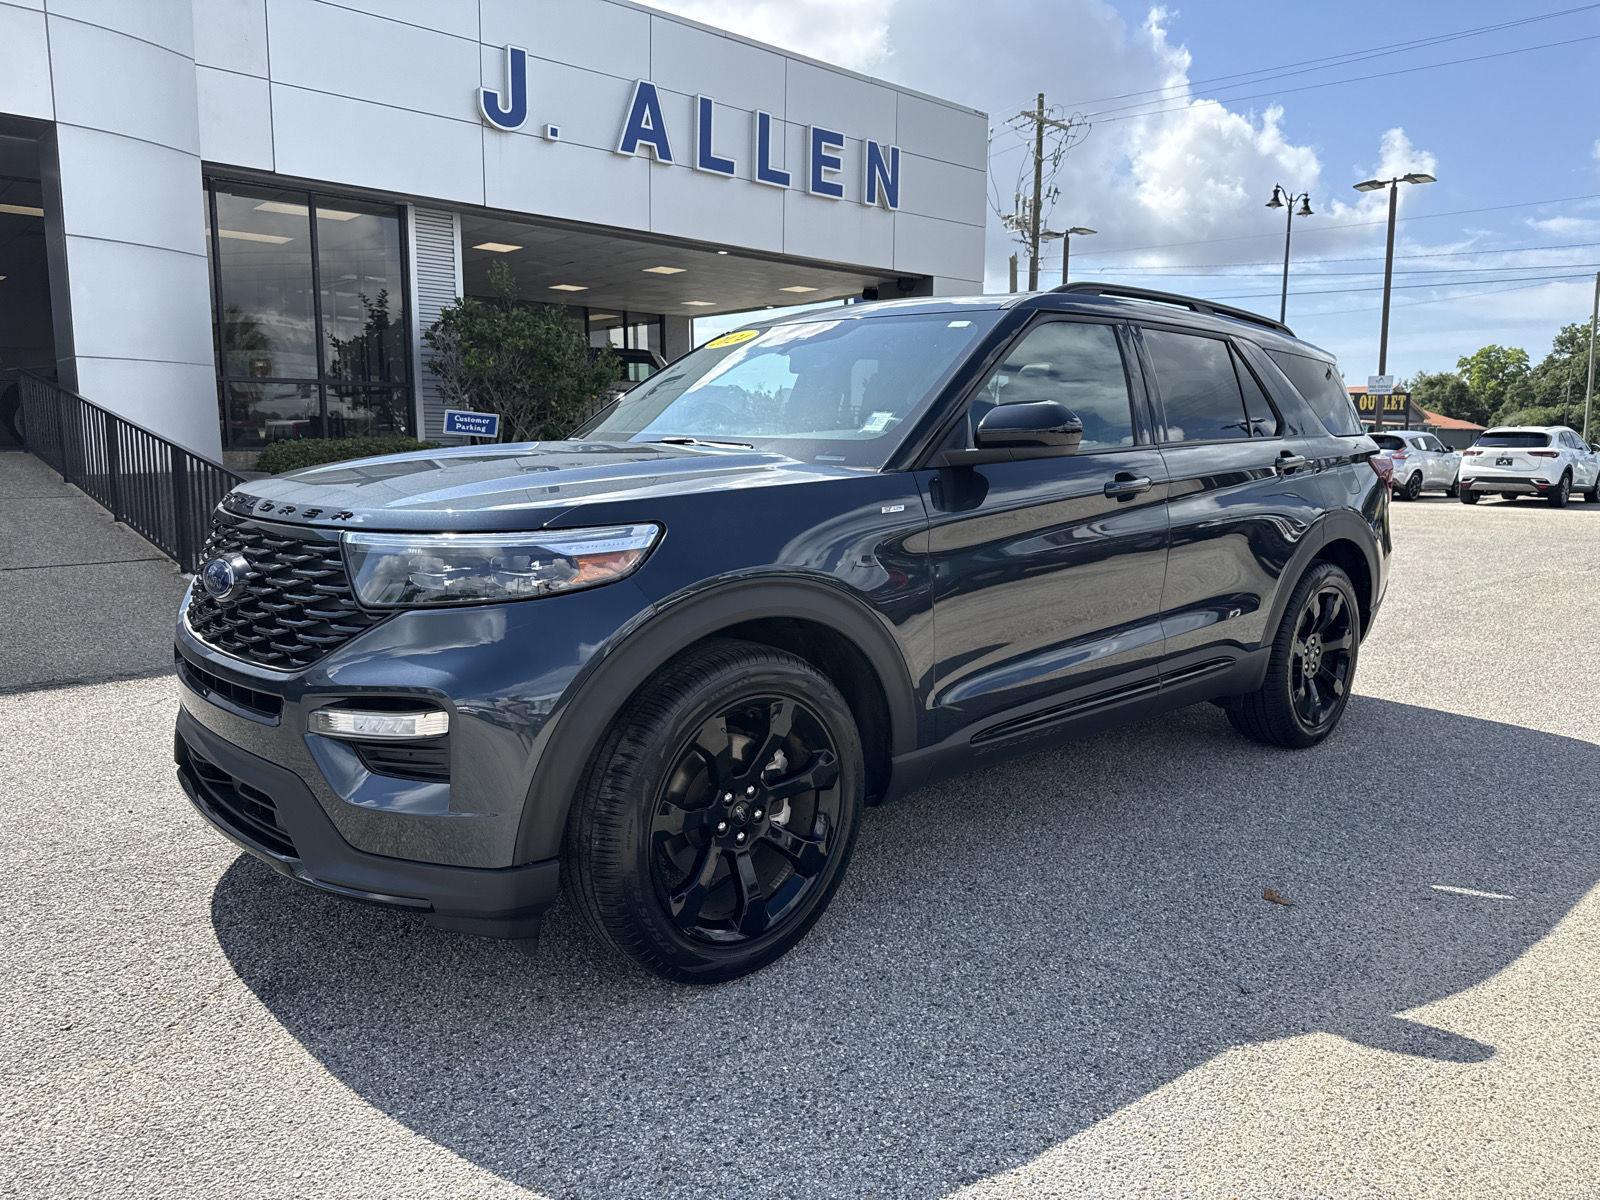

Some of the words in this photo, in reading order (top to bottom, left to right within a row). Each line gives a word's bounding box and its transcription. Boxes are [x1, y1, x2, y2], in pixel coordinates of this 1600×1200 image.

[477, 44, 560, 142] J.
[614, 78, 902, 211] ALLEN
[1359, 394, 1407, 411] OULET
[454, 415, 490, 424] Customer
[456, 423, 486, 433] Parking
